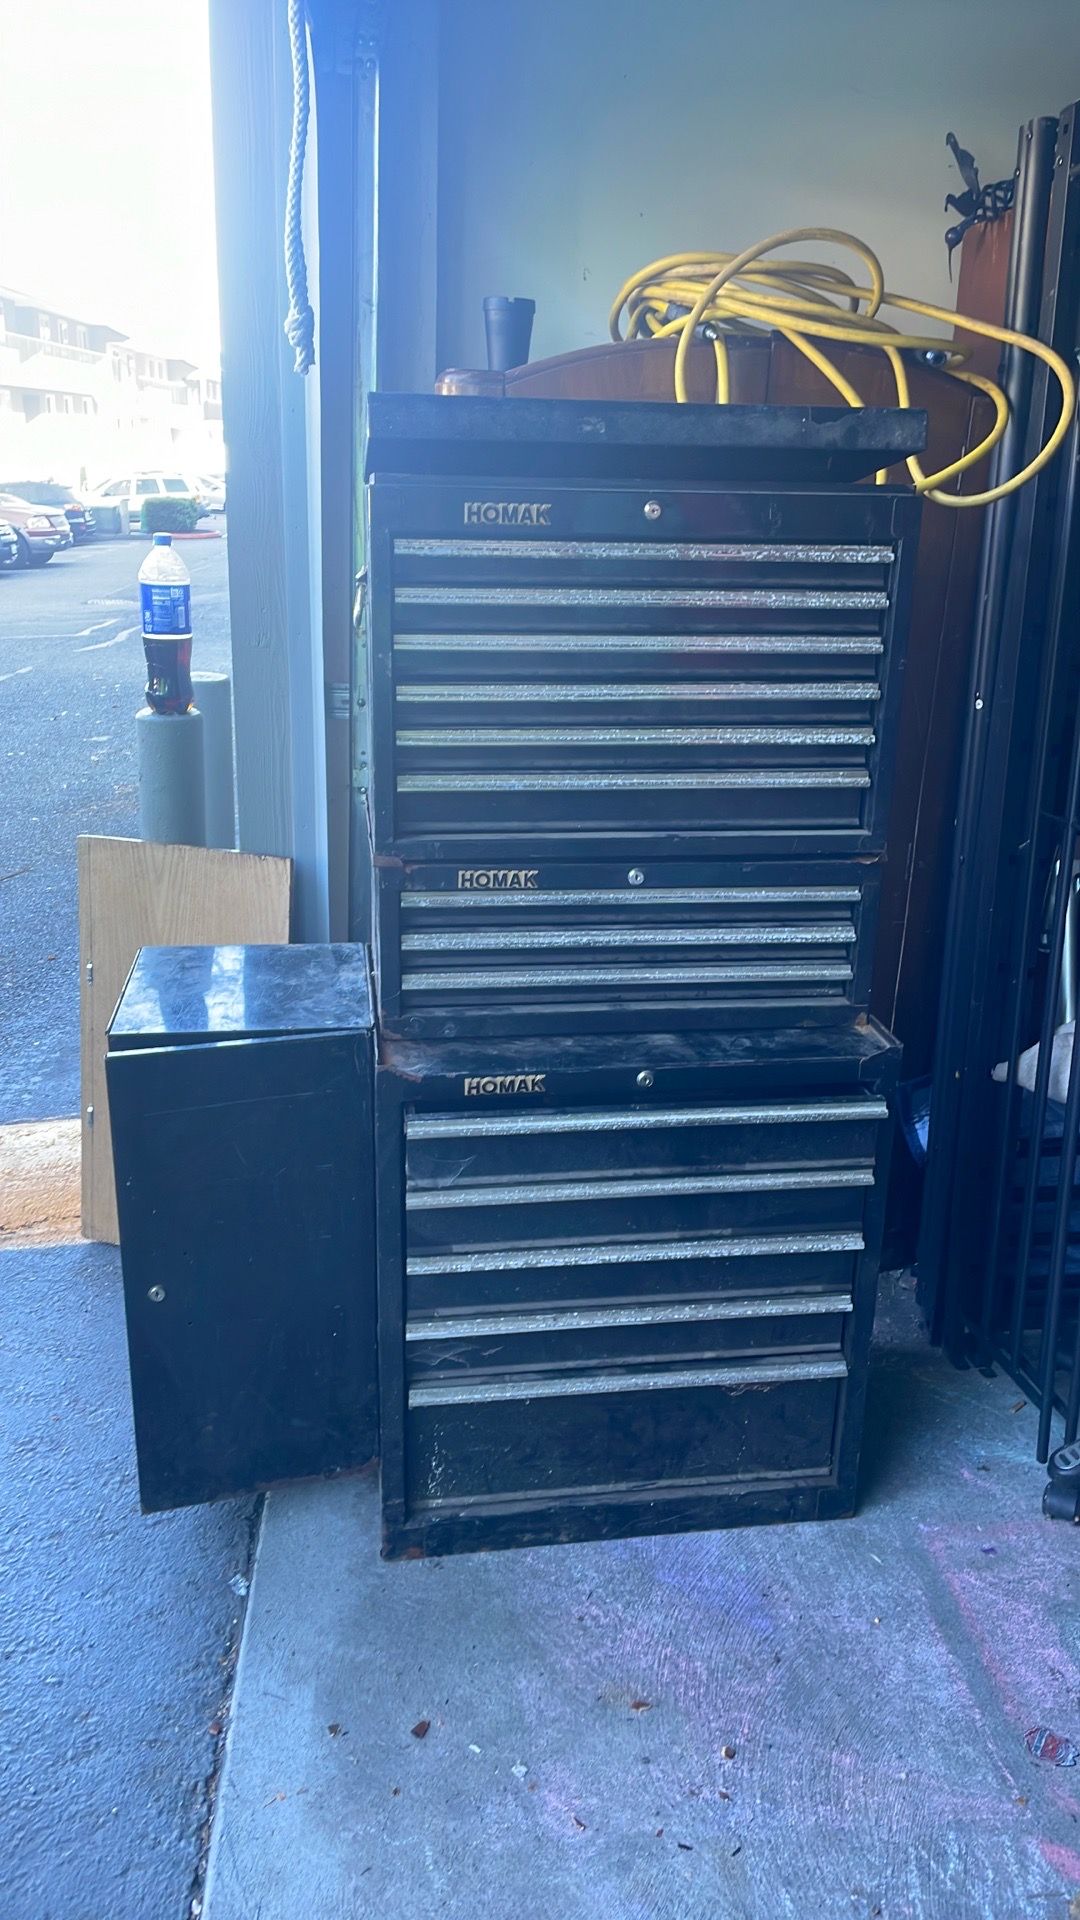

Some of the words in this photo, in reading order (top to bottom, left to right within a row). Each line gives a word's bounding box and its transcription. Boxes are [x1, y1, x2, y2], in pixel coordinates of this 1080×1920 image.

[464, 502, 551, 525] HOMAK
[458, 870, 538, 888] HOMAK
[464, 1074, 546, 1096] HOMAK
